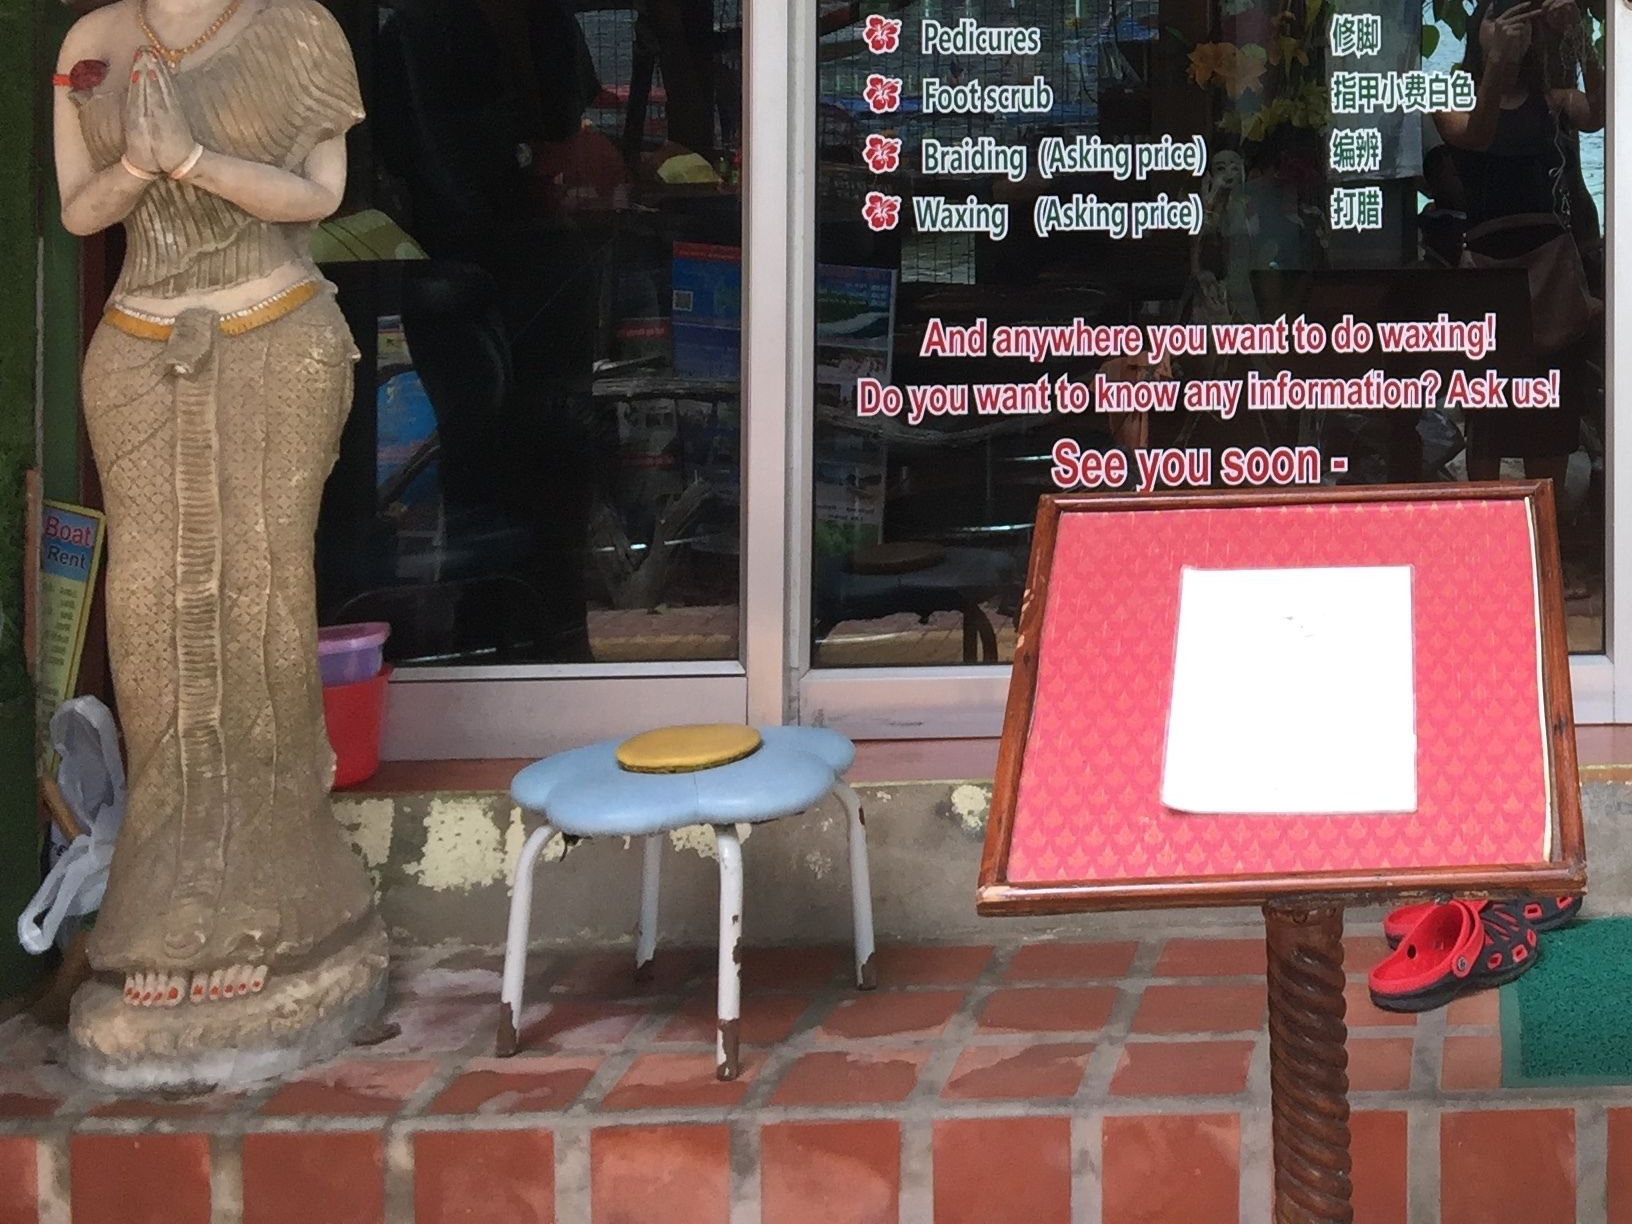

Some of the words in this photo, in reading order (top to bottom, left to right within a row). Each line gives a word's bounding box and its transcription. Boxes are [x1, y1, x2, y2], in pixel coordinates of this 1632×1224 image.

[921, 18, 1041, 57] Pedicures
[1331, 12, 1381, 57] 修脚
[921, 78, 981, 114] Foot
[982, 76, 1054, 114] scrub
[1331, 72, 1476, 115] 指甲小费白色
[921, 136, 1027, 181] Braiding
[1037, 134, 1132, 180] (Asking
[1134, 132, 1209, 181] price)
[912, 195, 1009, 240] Waxing
[1032, 192, 1129, 238] (Asking
[1130, 192, 1203, 238] price)
[920, 317, 986, 357] And
[992, 317, 1142, 362] anywhere
[1146, 324, 1209, 364] you
[1212, 314, 1290, 355] want
[1292, 314, 1328, 354] to
[1331, 314, 1372, 352] do
[1376, 312, 1496, 358] waxing!
[856, 377, 902, 417] Do
[906, 382, 970, 425] you
[974, 374, 1051, 415] want
[1054, 372, 1090, 412] to
[1094, 371, 1181, 412] know
[1182, 376, 1242, 418] any
[1246, 370, 1440, 411] information?
[1445, 370, 1509, 408] Ask
[1511, 368, 1561, 407] us!
[1050, 438, 1130, 490] See
[1134, 446, 1215, 494] you
[44, 516, 91, 546] Boat
[47, 545, 87, 569] Rent
